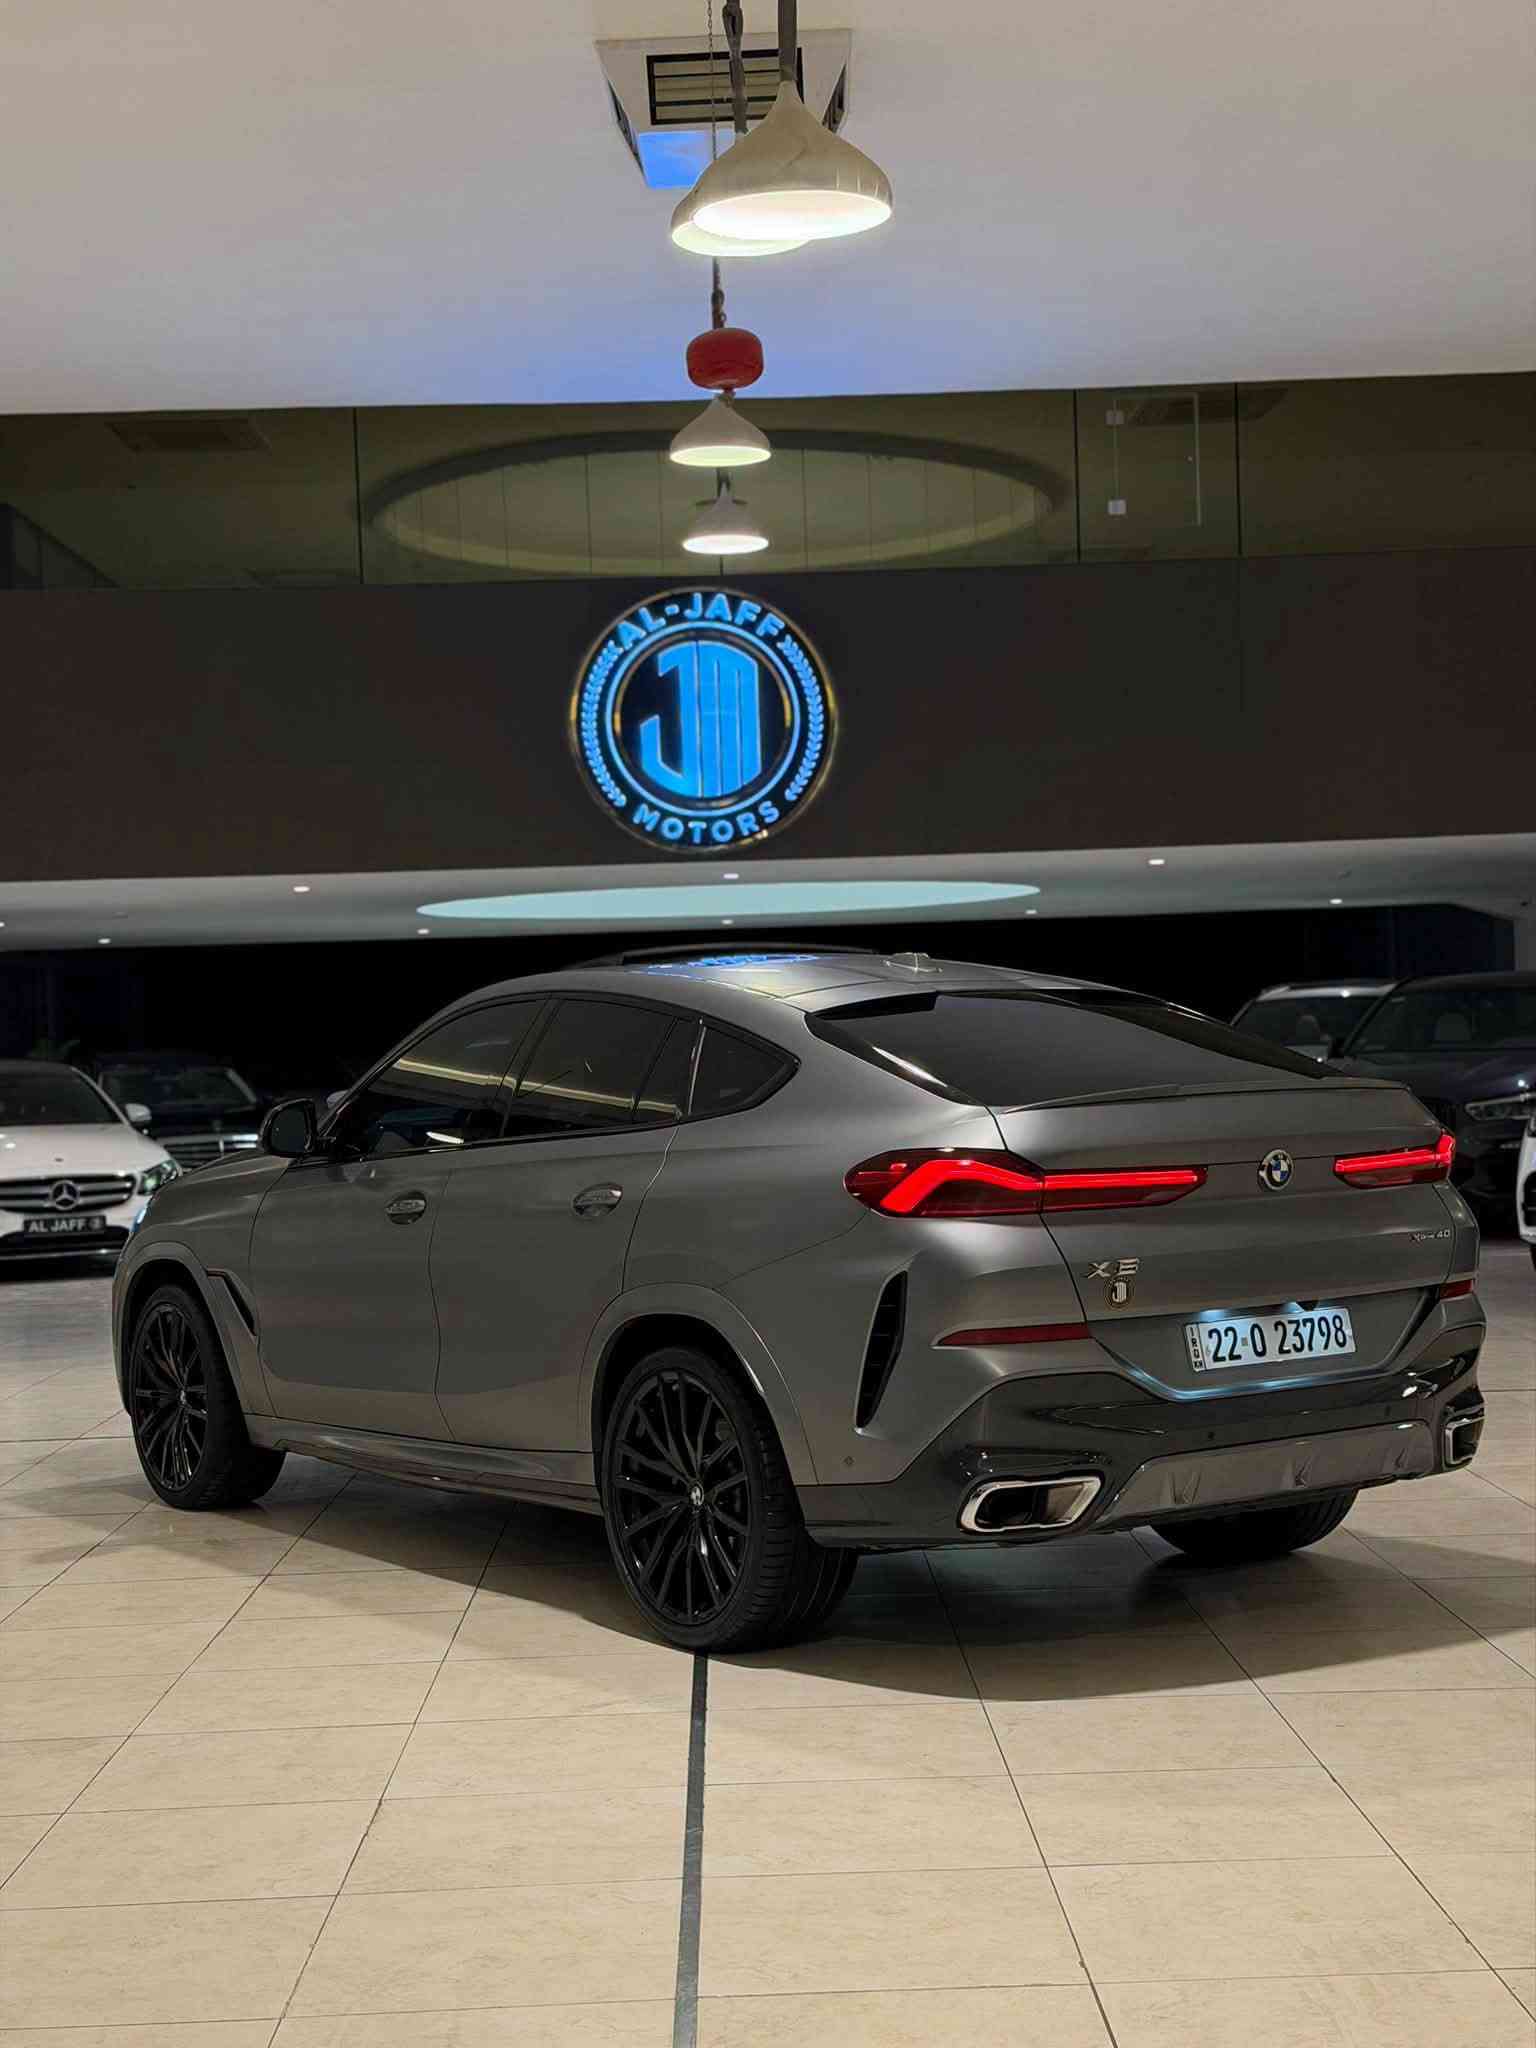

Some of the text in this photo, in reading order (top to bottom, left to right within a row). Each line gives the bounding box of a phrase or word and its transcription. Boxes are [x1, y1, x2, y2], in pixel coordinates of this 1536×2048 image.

[616, 592, 785, 650] AL-JAFF
[632, 800, 780, 844] MOTORS
[28, 1218, 86, 1233] AL JAFF
[1207, 1326, 1242, 1363] 22
[1273, 1314, 1347, 1355] 23798
